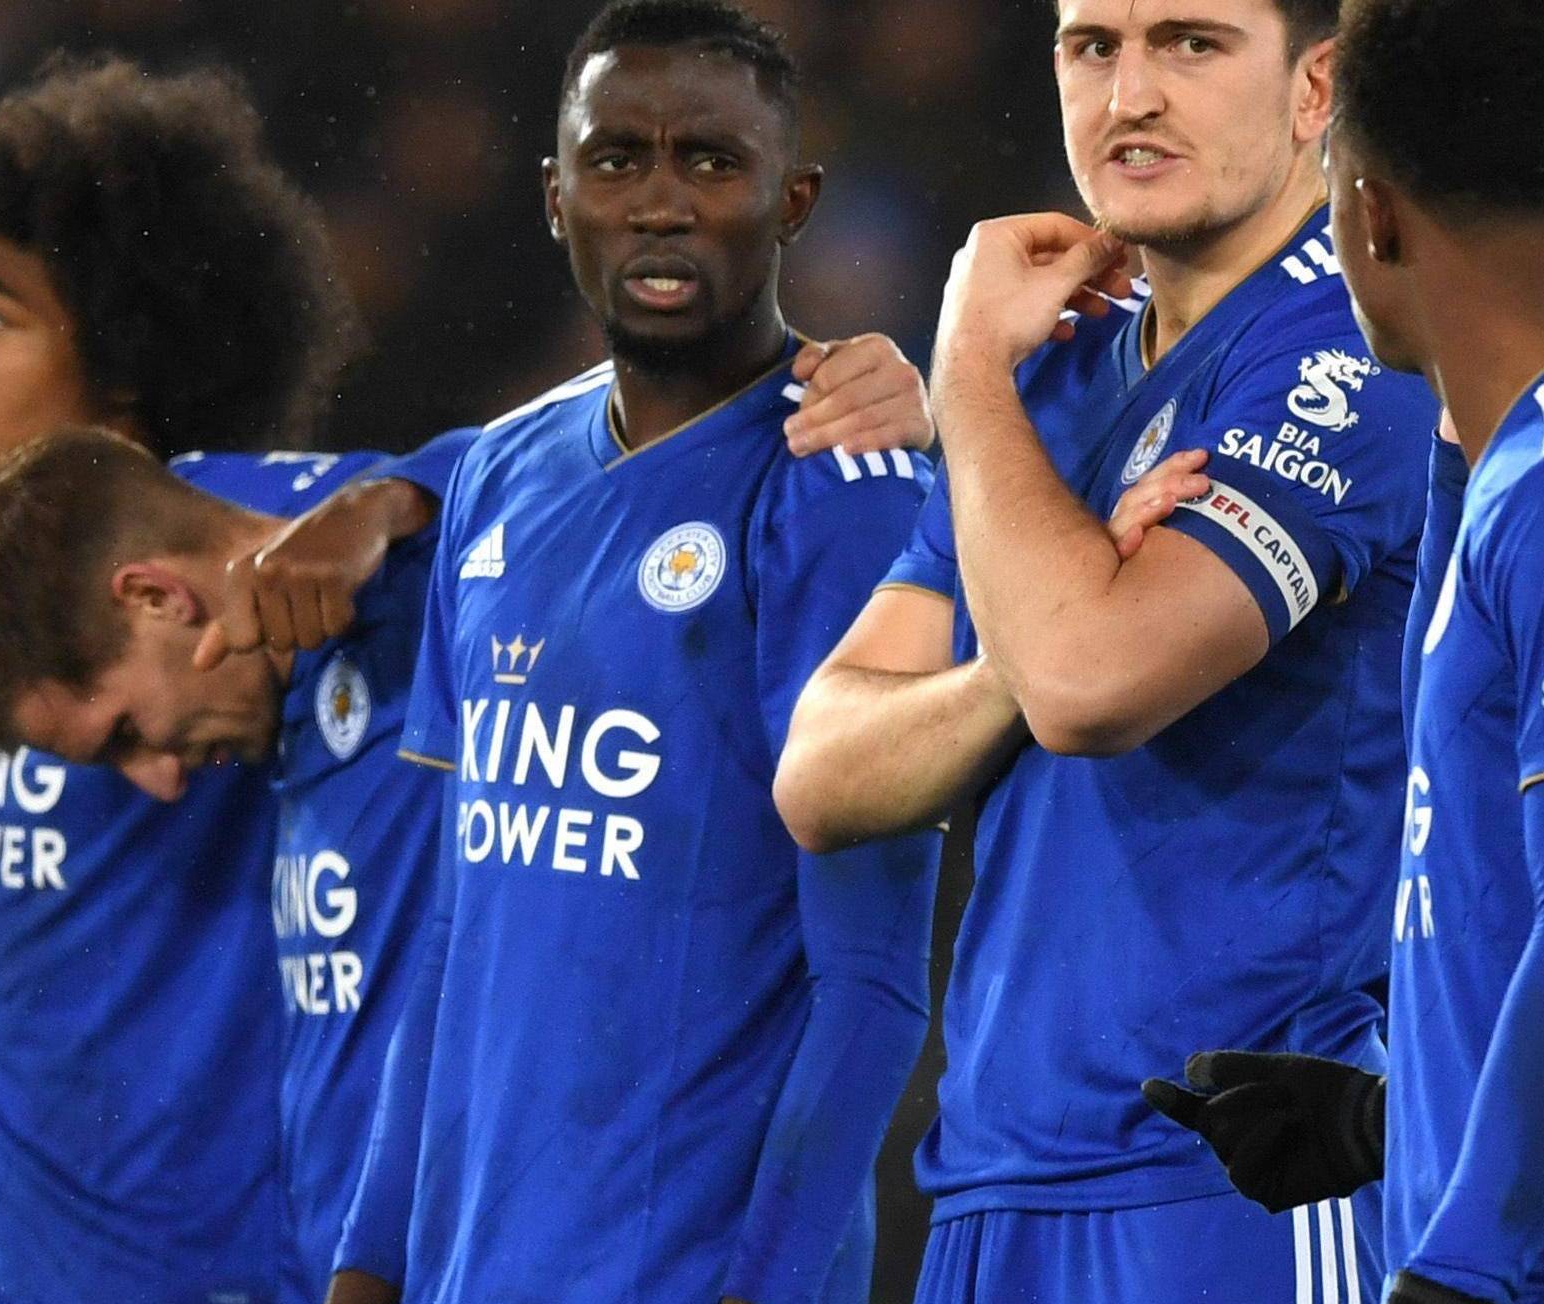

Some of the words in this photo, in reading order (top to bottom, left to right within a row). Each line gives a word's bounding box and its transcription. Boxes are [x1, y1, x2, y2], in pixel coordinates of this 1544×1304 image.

[1217, 428, 1352, 505] SAIGON
[1276, 421, 1320, 456] BIA
[1210, 494, 1250, 529] EFL
[1254, 525, 1312, 615] CAPTAIN
[461, 698, 661, 798] KING
